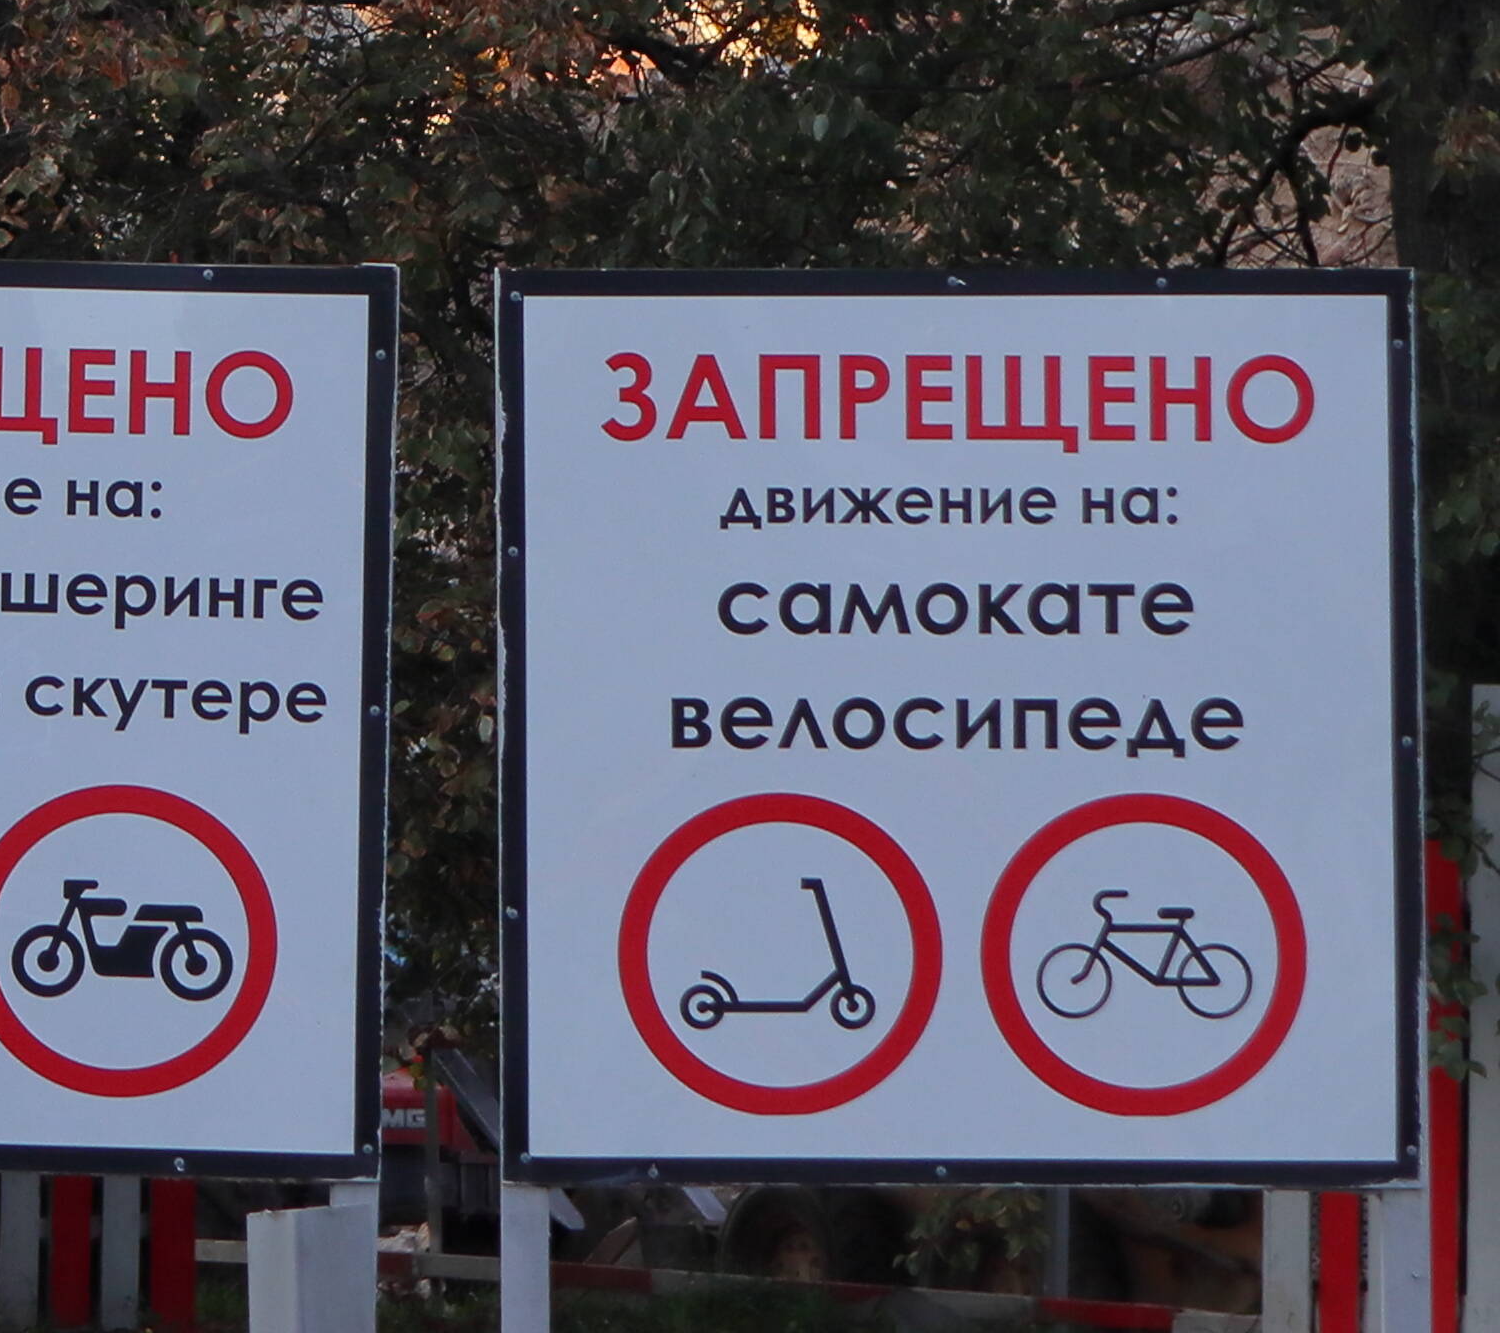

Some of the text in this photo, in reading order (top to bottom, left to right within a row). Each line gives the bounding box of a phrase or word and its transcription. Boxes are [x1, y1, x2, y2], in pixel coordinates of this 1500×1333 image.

[601, 352, 1315, 454] ЗАПРЕЩЕНО
[66, 478, 162, 519] на:
[719, 485, 1179, 530] движение на:
[717, 581, 1194, 636] самокате
[25, 674, 327, 735] скутере
[671, 695, 1244, 758] велосипеде
